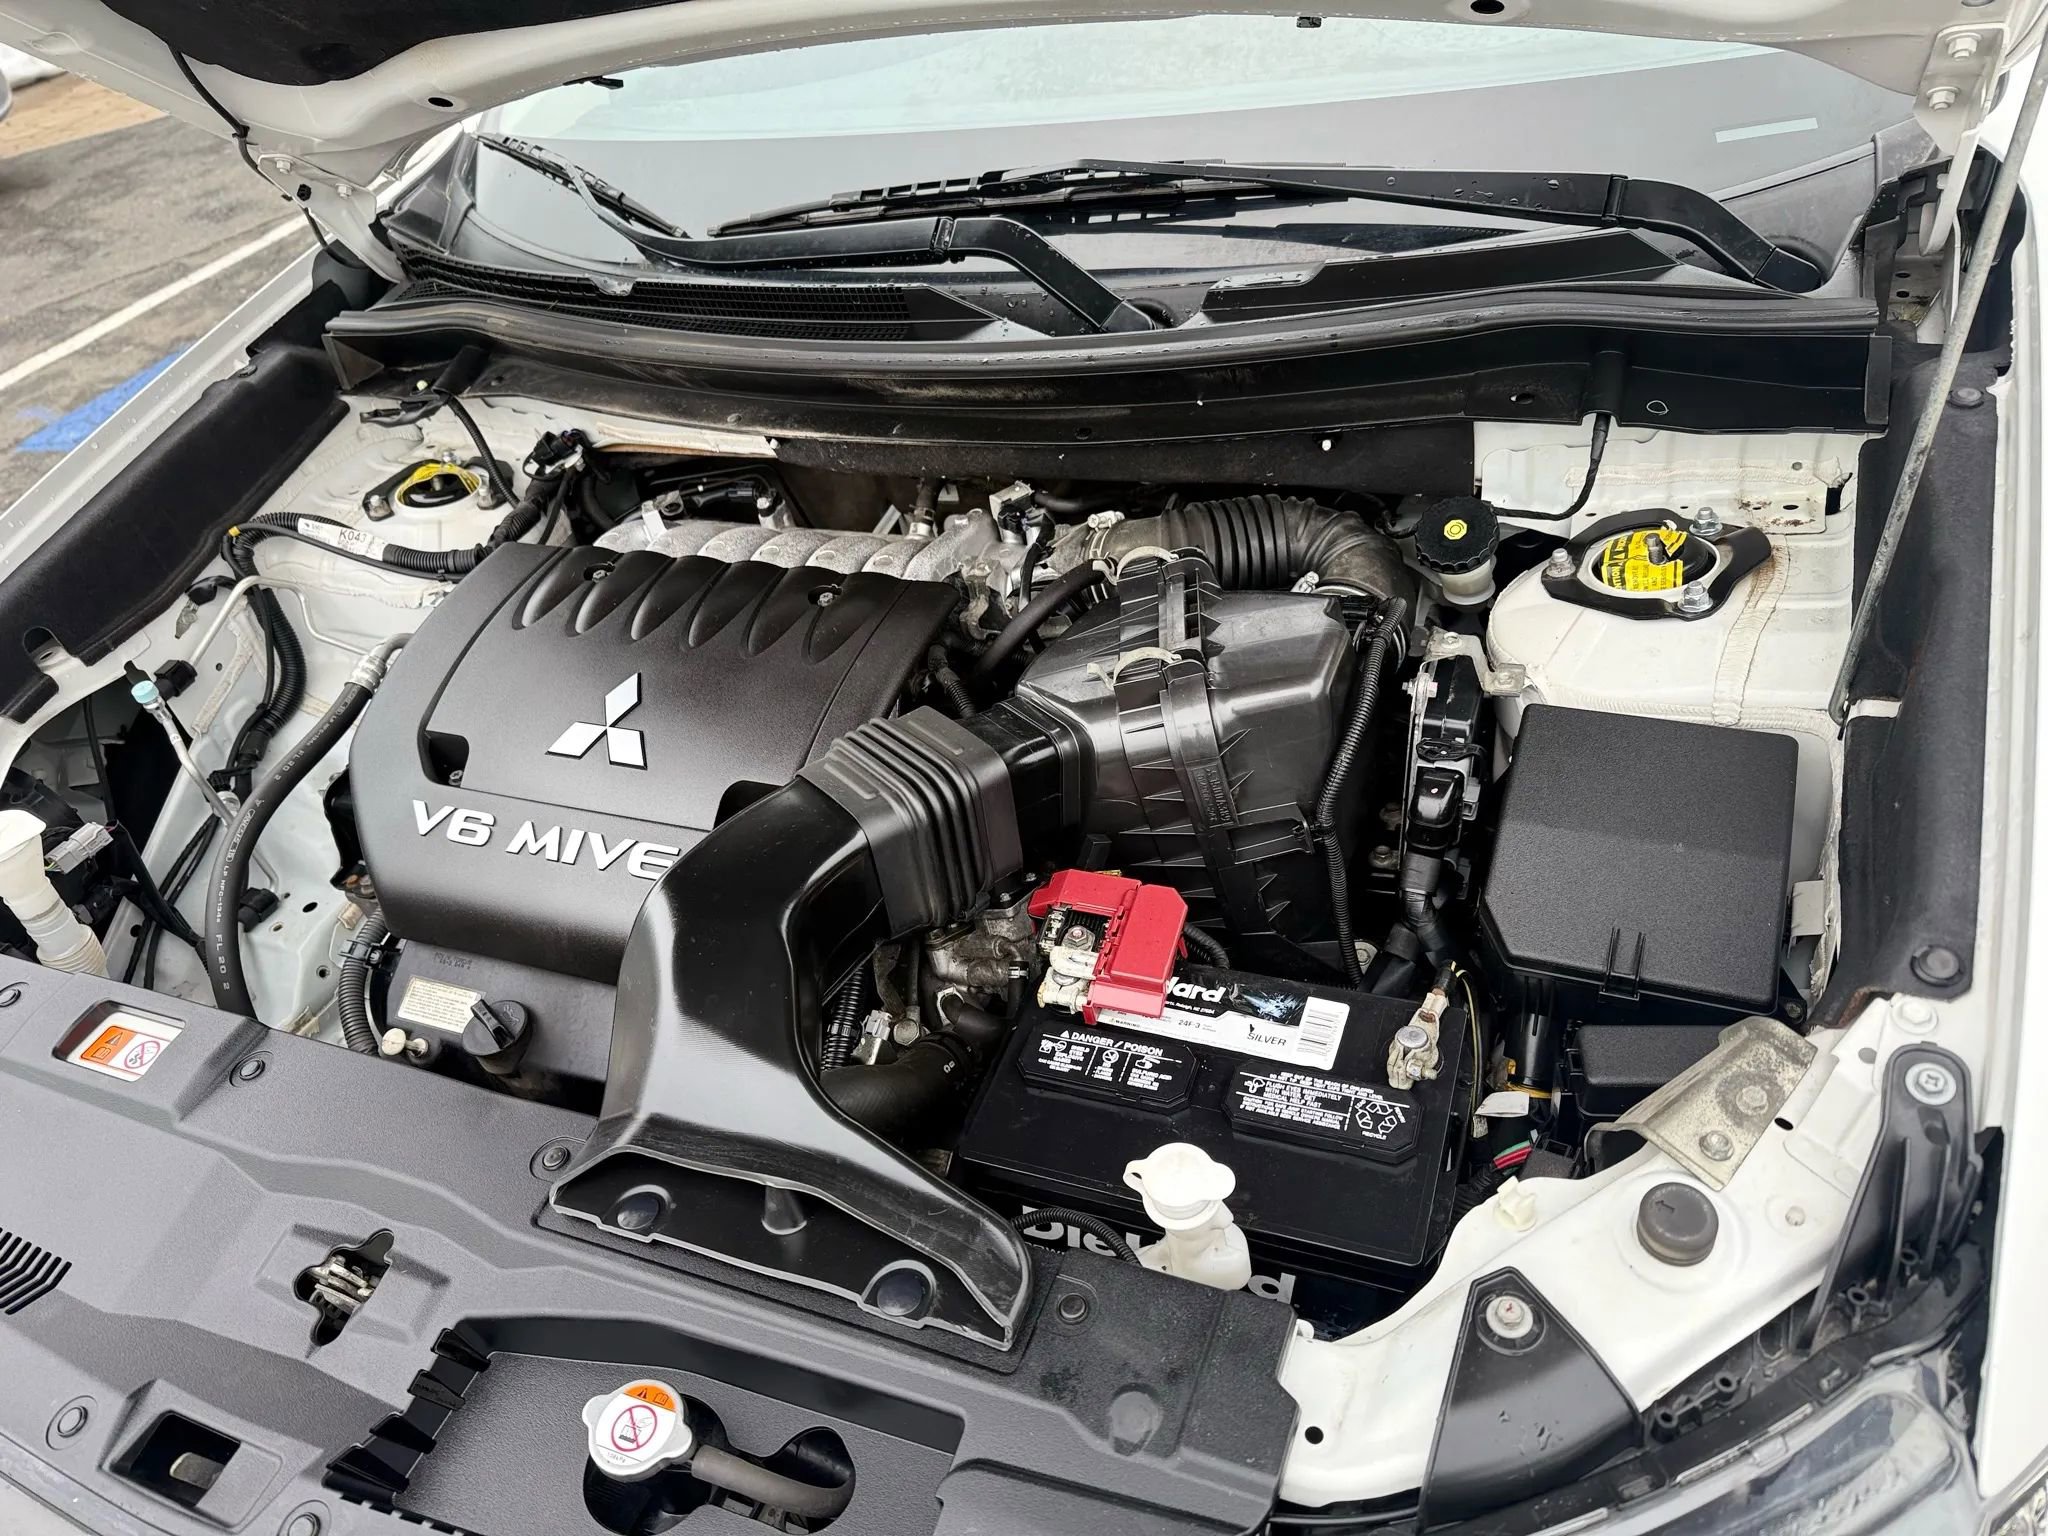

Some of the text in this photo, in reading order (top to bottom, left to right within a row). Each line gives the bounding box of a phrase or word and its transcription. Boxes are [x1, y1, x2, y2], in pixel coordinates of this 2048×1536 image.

[413, 800, 681, 880] V6 MIVE
[216, 934, 222, 951] FL
[218, 956, 226, 974] 20
[1071, 1032, 1114, 1046] DANGER
[1124, 1042, 1163, 1056] POISON
[1247, 1032, 1286, 1046] SILVER
[1266, 1081, 1285, 1090] FLUSH
[1303, 1089, 1341, 1101] IMMEDIATELY
[1290, 1097, 1305, 1105] HELP
